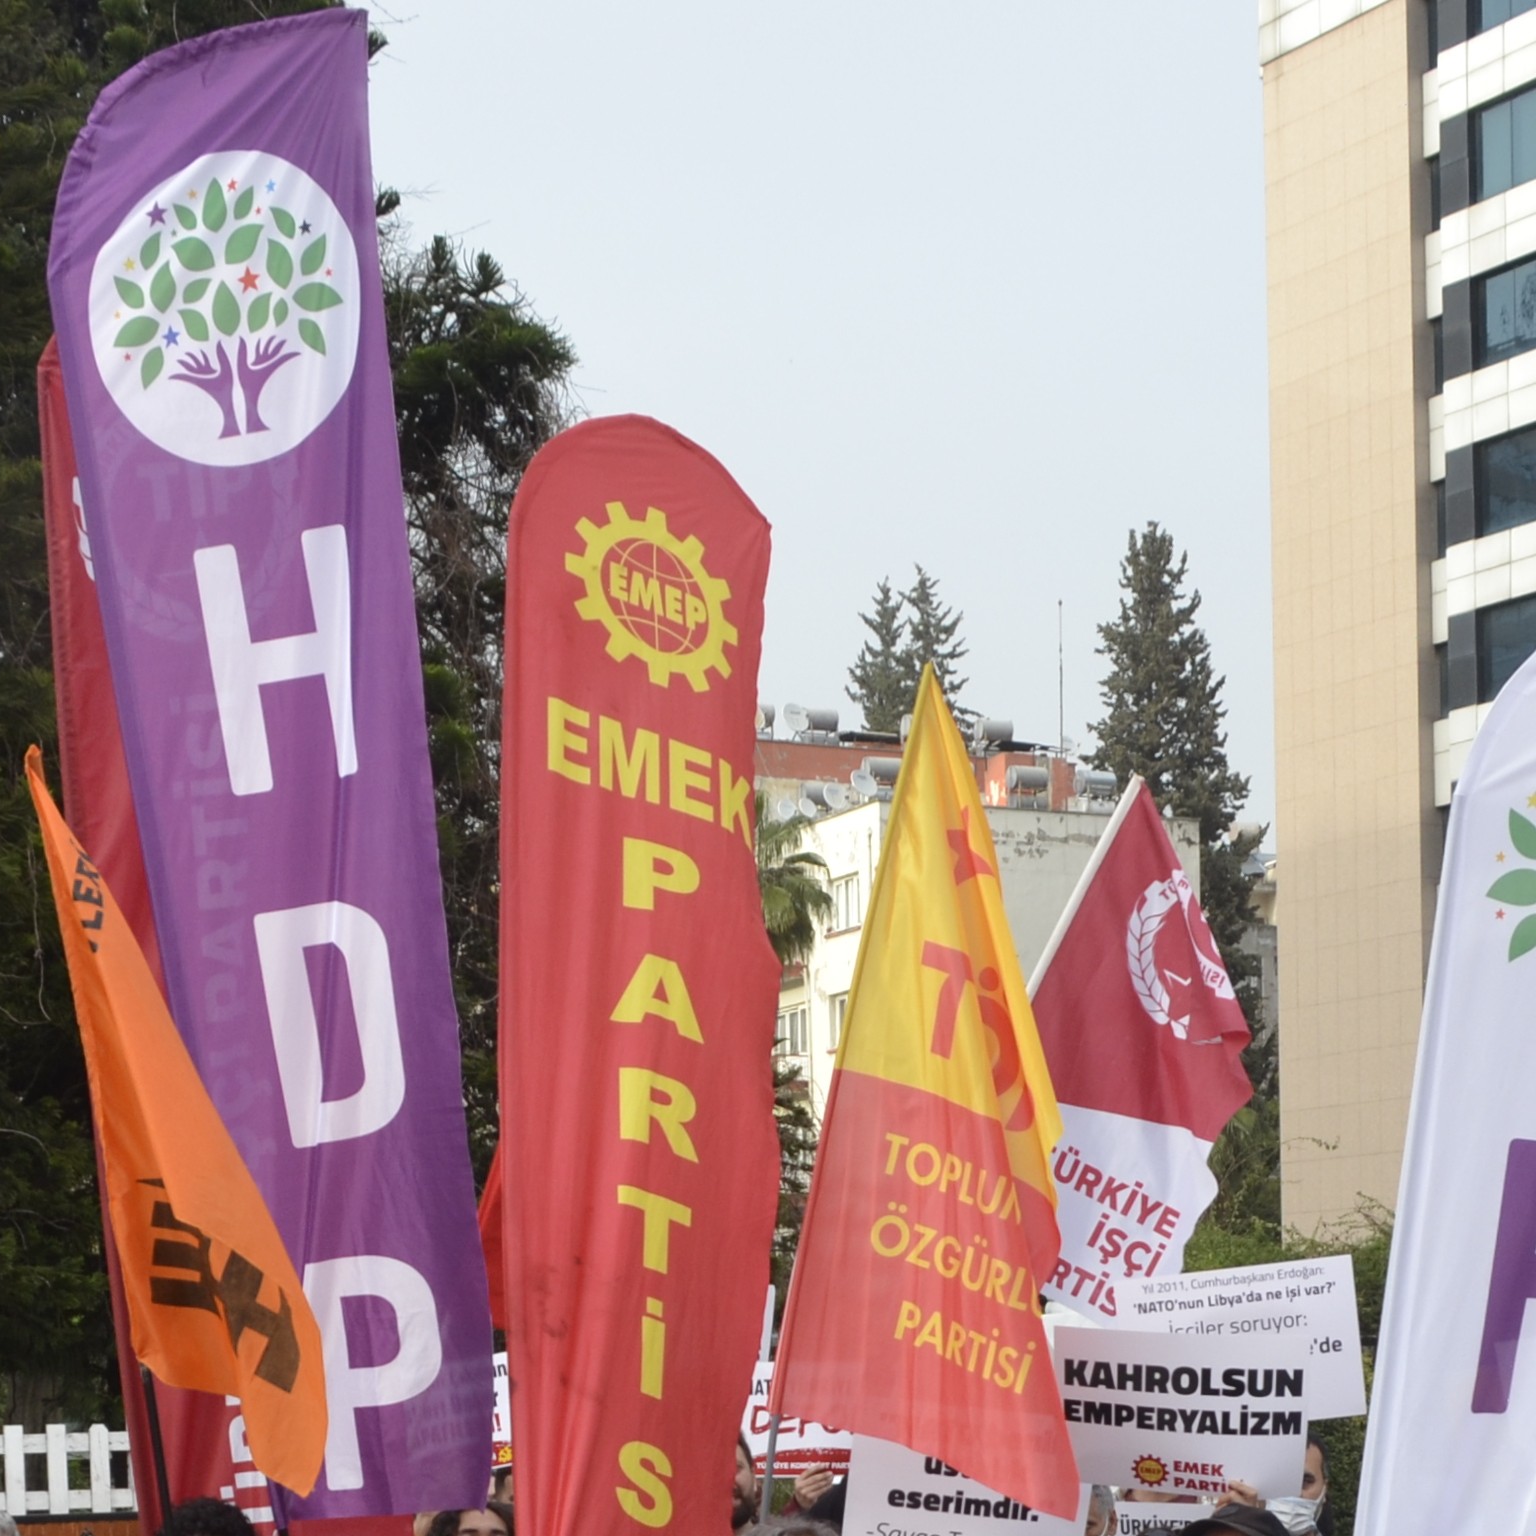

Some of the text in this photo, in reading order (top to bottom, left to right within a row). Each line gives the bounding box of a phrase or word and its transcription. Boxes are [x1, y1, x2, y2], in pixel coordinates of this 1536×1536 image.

[610, 561, 707, 630] EMEP
[548, 696, 753, 853] EMEK
[194, 524, 442, 1491] HDP
[1051, 1146, 1181, 1240] ÜRKİYE
[870, 1202, 1043, 1319] ÖZGÜRL
[1086, 1213, 1167, 1278] İŞÇİ
[1046, 1257, 1117, 1317] RTİS
[1190, 1271, 1275, 1291] Cumhurbaşkanı
[1266, 1289, 1282, 1301] ne
[894, 1300, 1037, 1394] PARTİSİ
[1064, 1359, 1303, 1397] KAHROLSUN
[1064, 1399, 1302, 1436] EMPERYALİZM
[1172, 1460, 1224, 1477] EMEK
[1173, 1476, 1230, 1493] PARTİ
